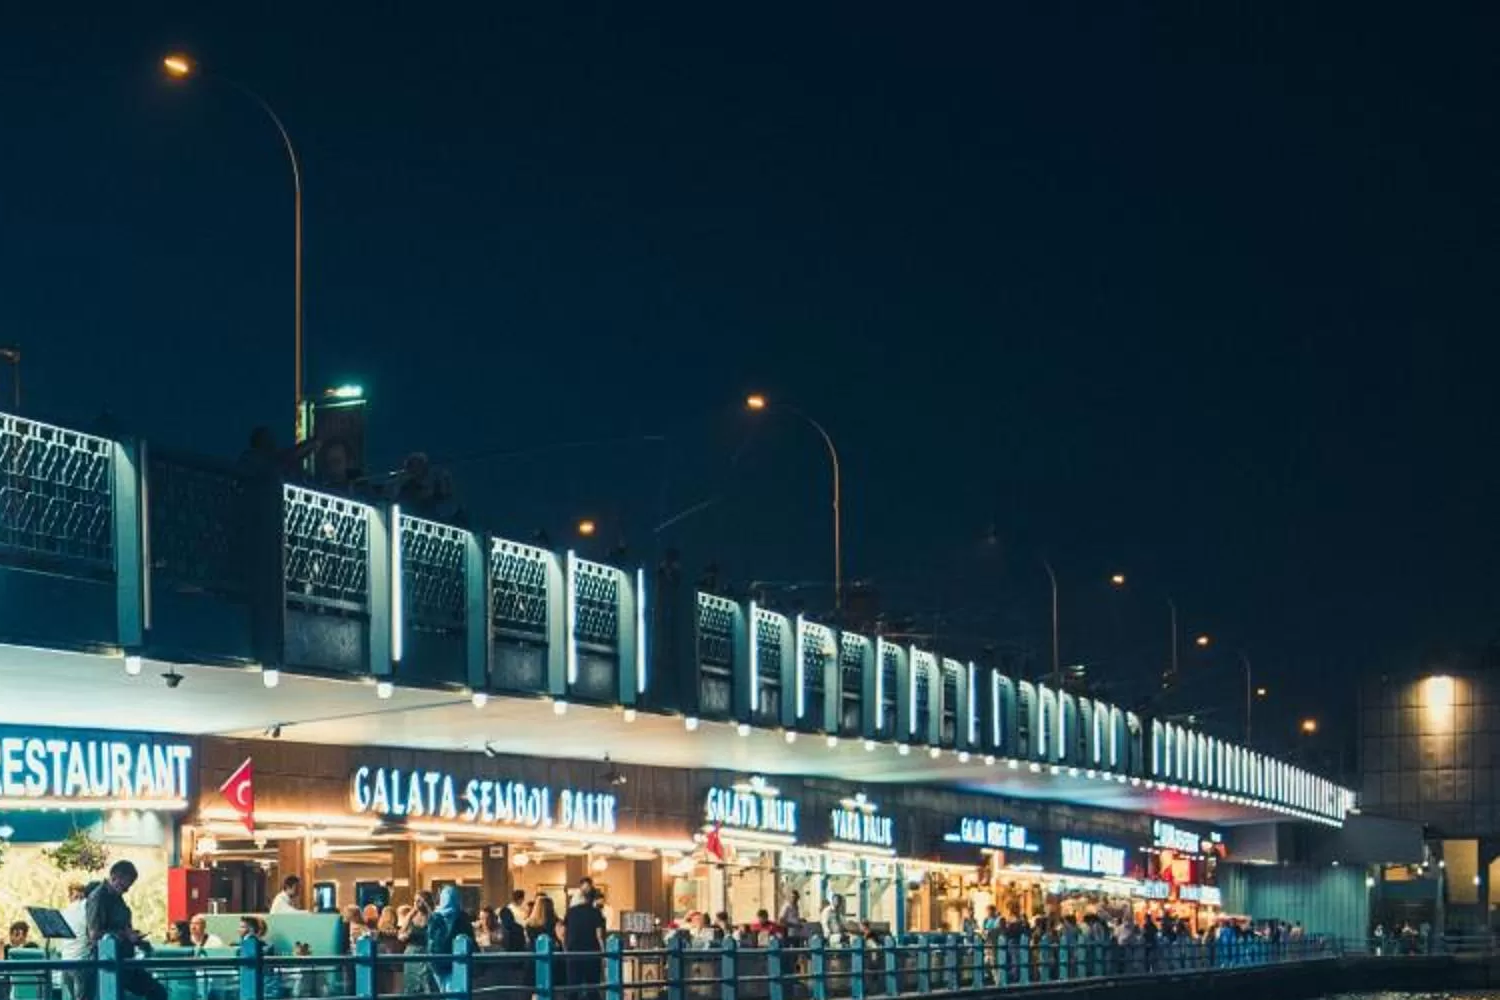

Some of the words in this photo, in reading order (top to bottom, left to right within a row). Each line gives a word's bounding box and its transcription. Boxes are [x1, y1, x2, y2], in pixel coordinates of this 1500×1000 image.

[353, 766, 456, 818] GALATA
[465, 778, 553, 829] SEMBOL
[560, 788, 617, 833] BALIK
